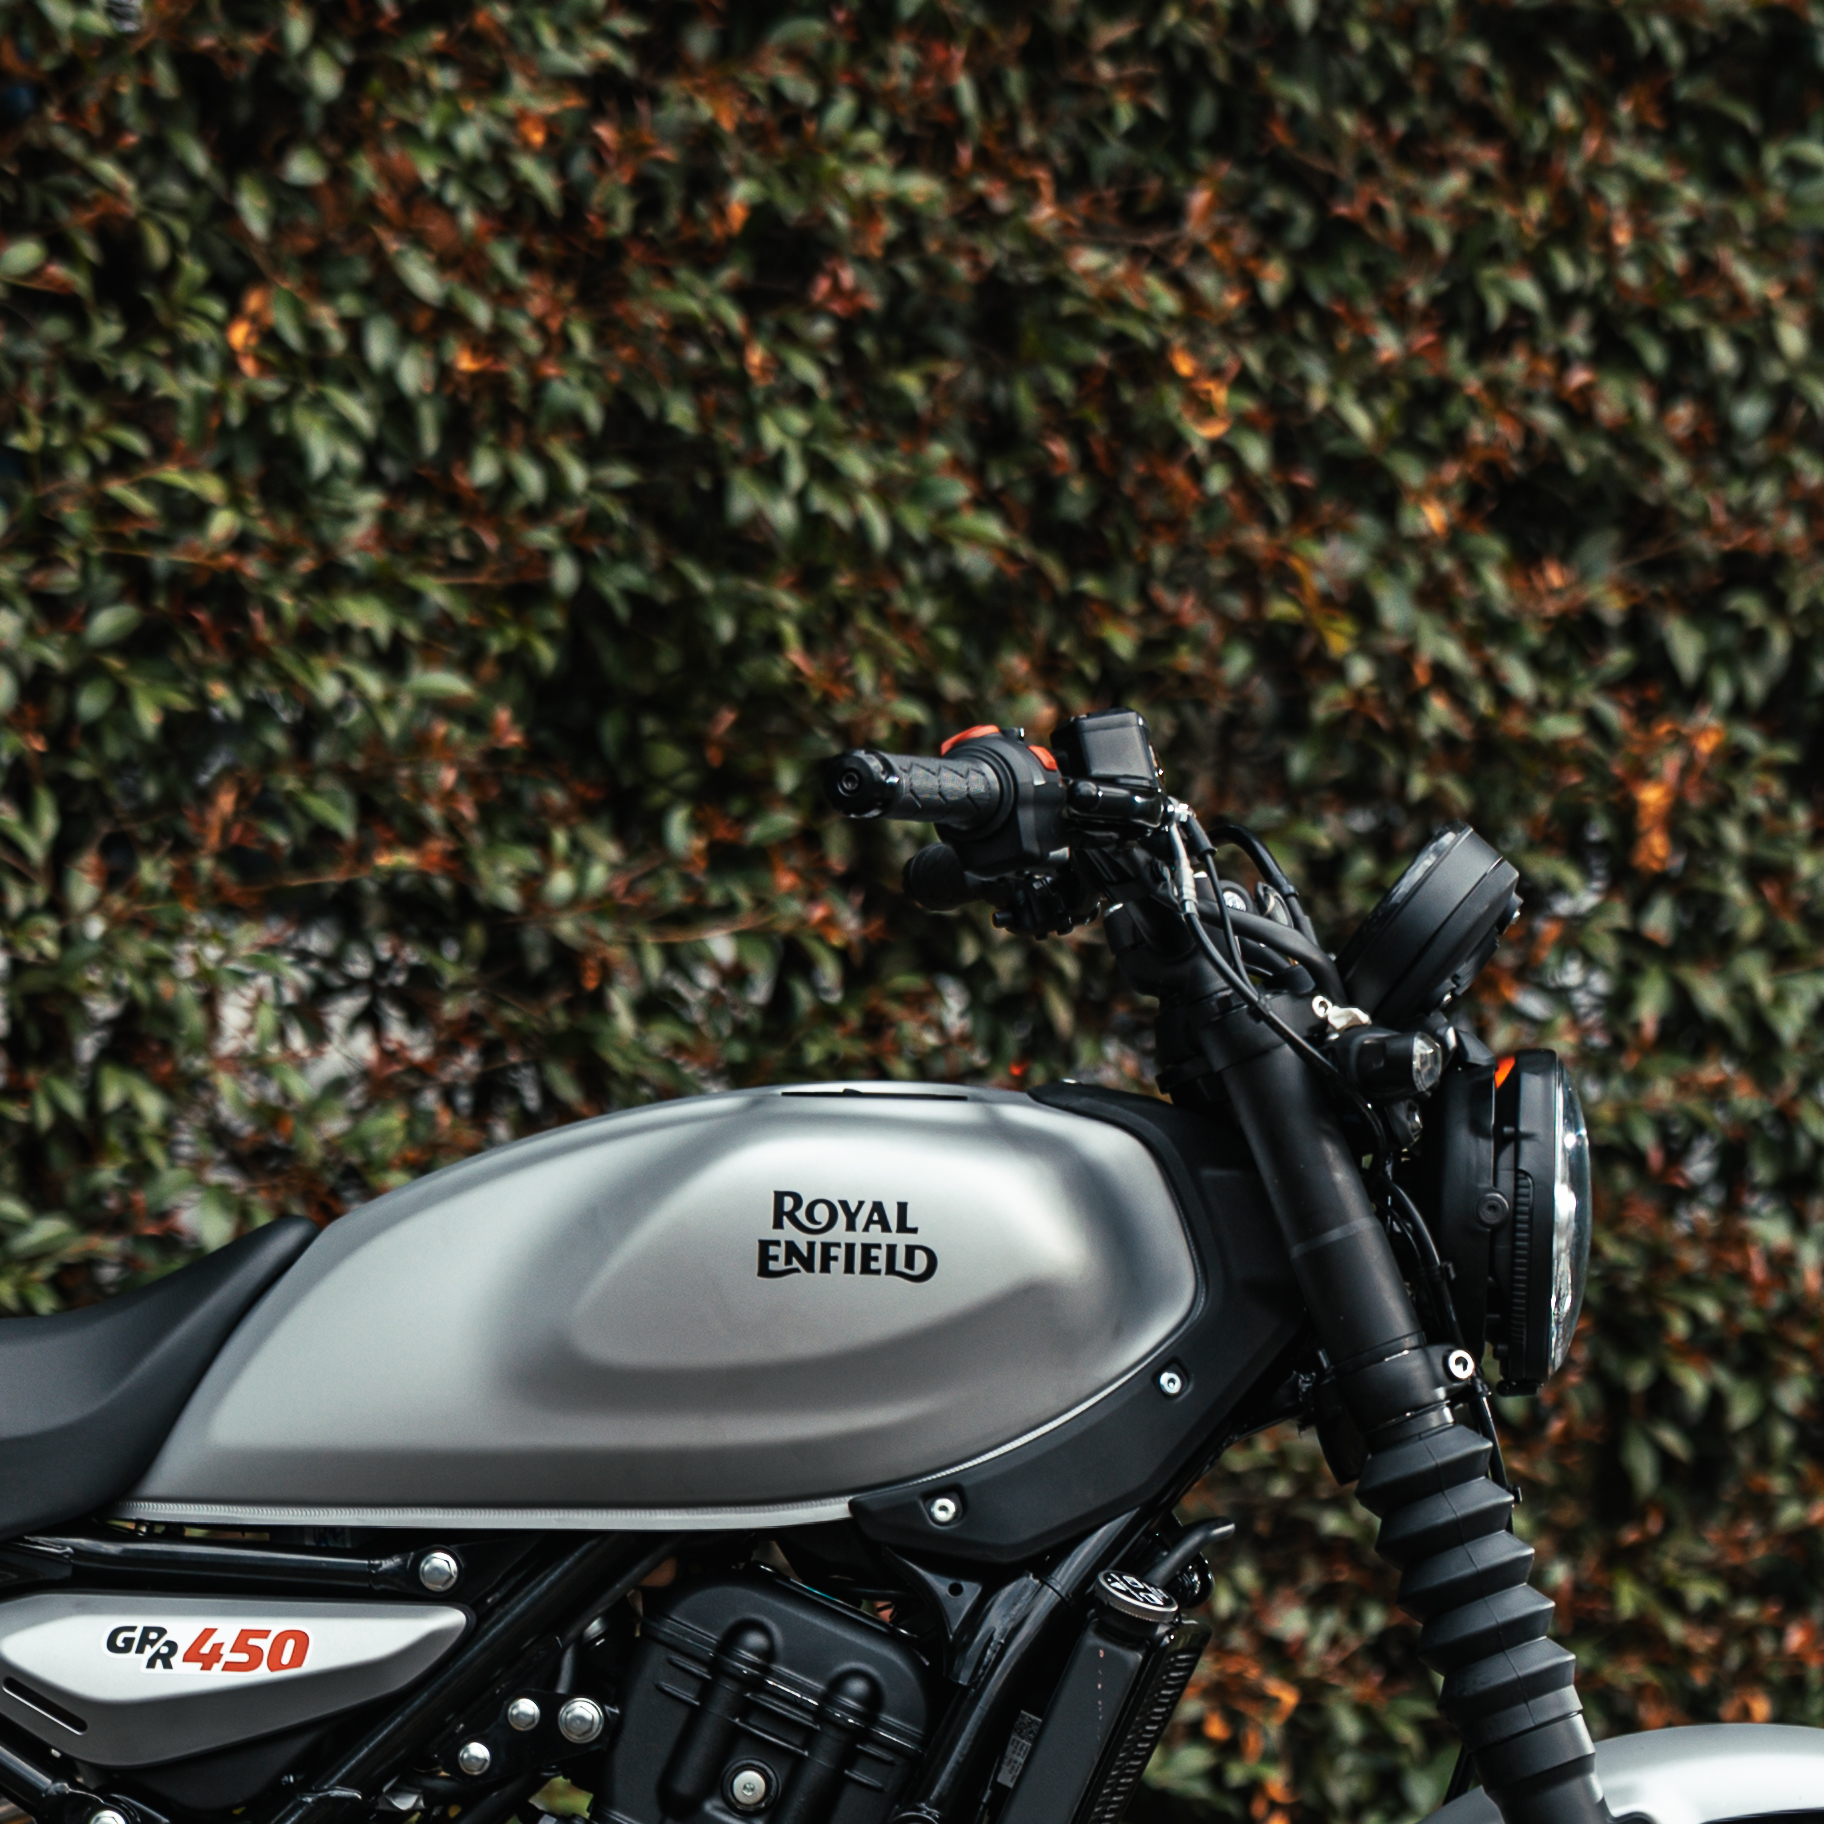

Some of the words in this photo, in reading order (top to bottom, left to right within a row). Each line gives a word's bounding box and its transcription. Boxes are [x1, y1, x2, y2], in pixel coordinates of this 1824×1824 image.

[772, 1190, 919, 1235] ROYAL
[757, 1239, 938, 1283] ENFIELD
[182, 1628, 310, 1672] 450
